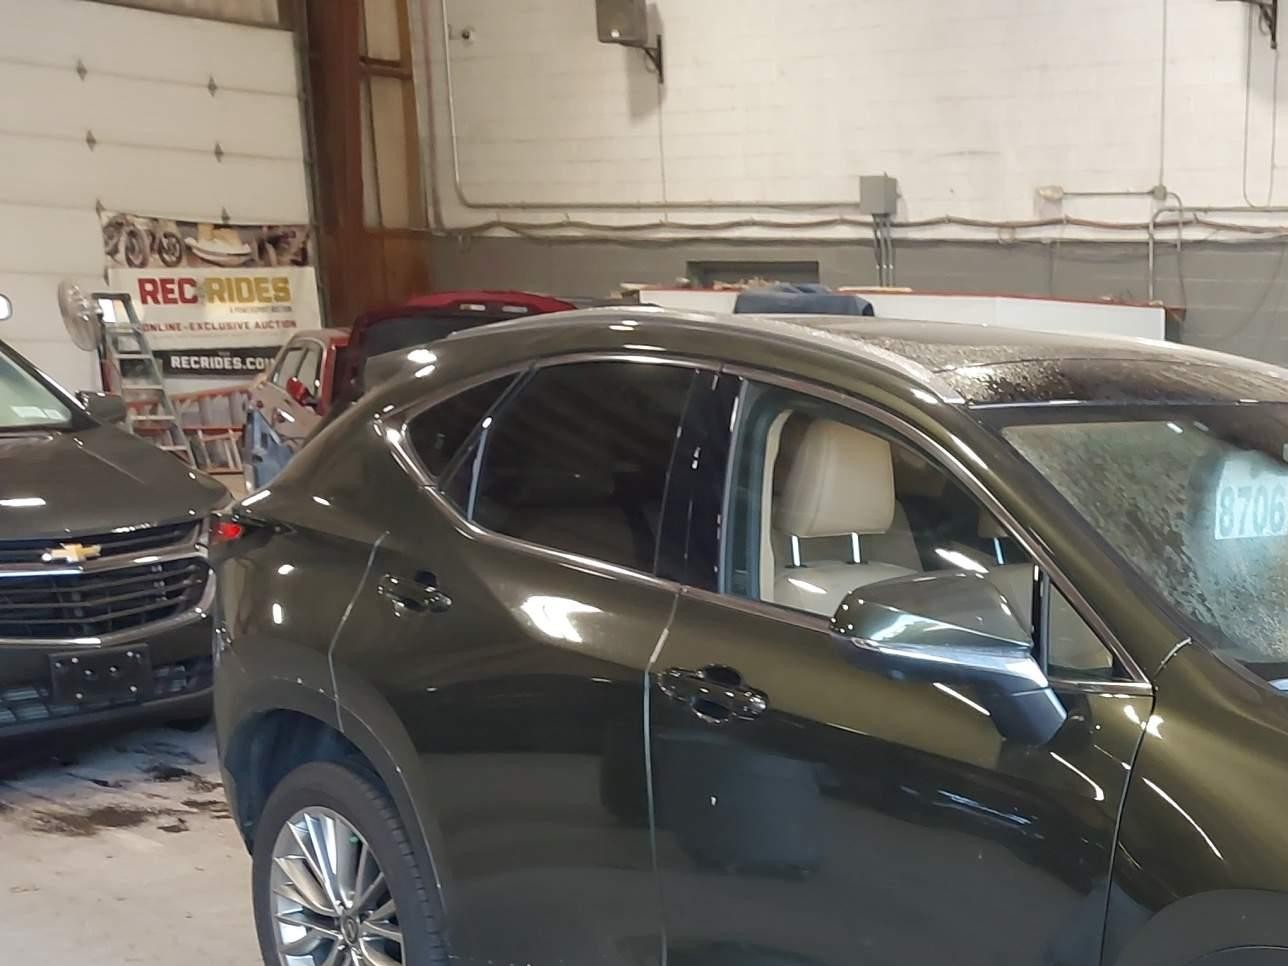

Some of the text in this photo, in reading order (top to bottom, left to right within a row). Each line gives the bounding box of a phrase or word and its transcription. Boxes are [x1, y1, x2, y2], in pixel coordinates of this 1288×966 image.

[138, 277, 292, 305] REC RIDES
[142, 320, 297, 333] ONLINE-EXCLUSIVE AUCTION
[1219, 485, 1286, 536] 8706
